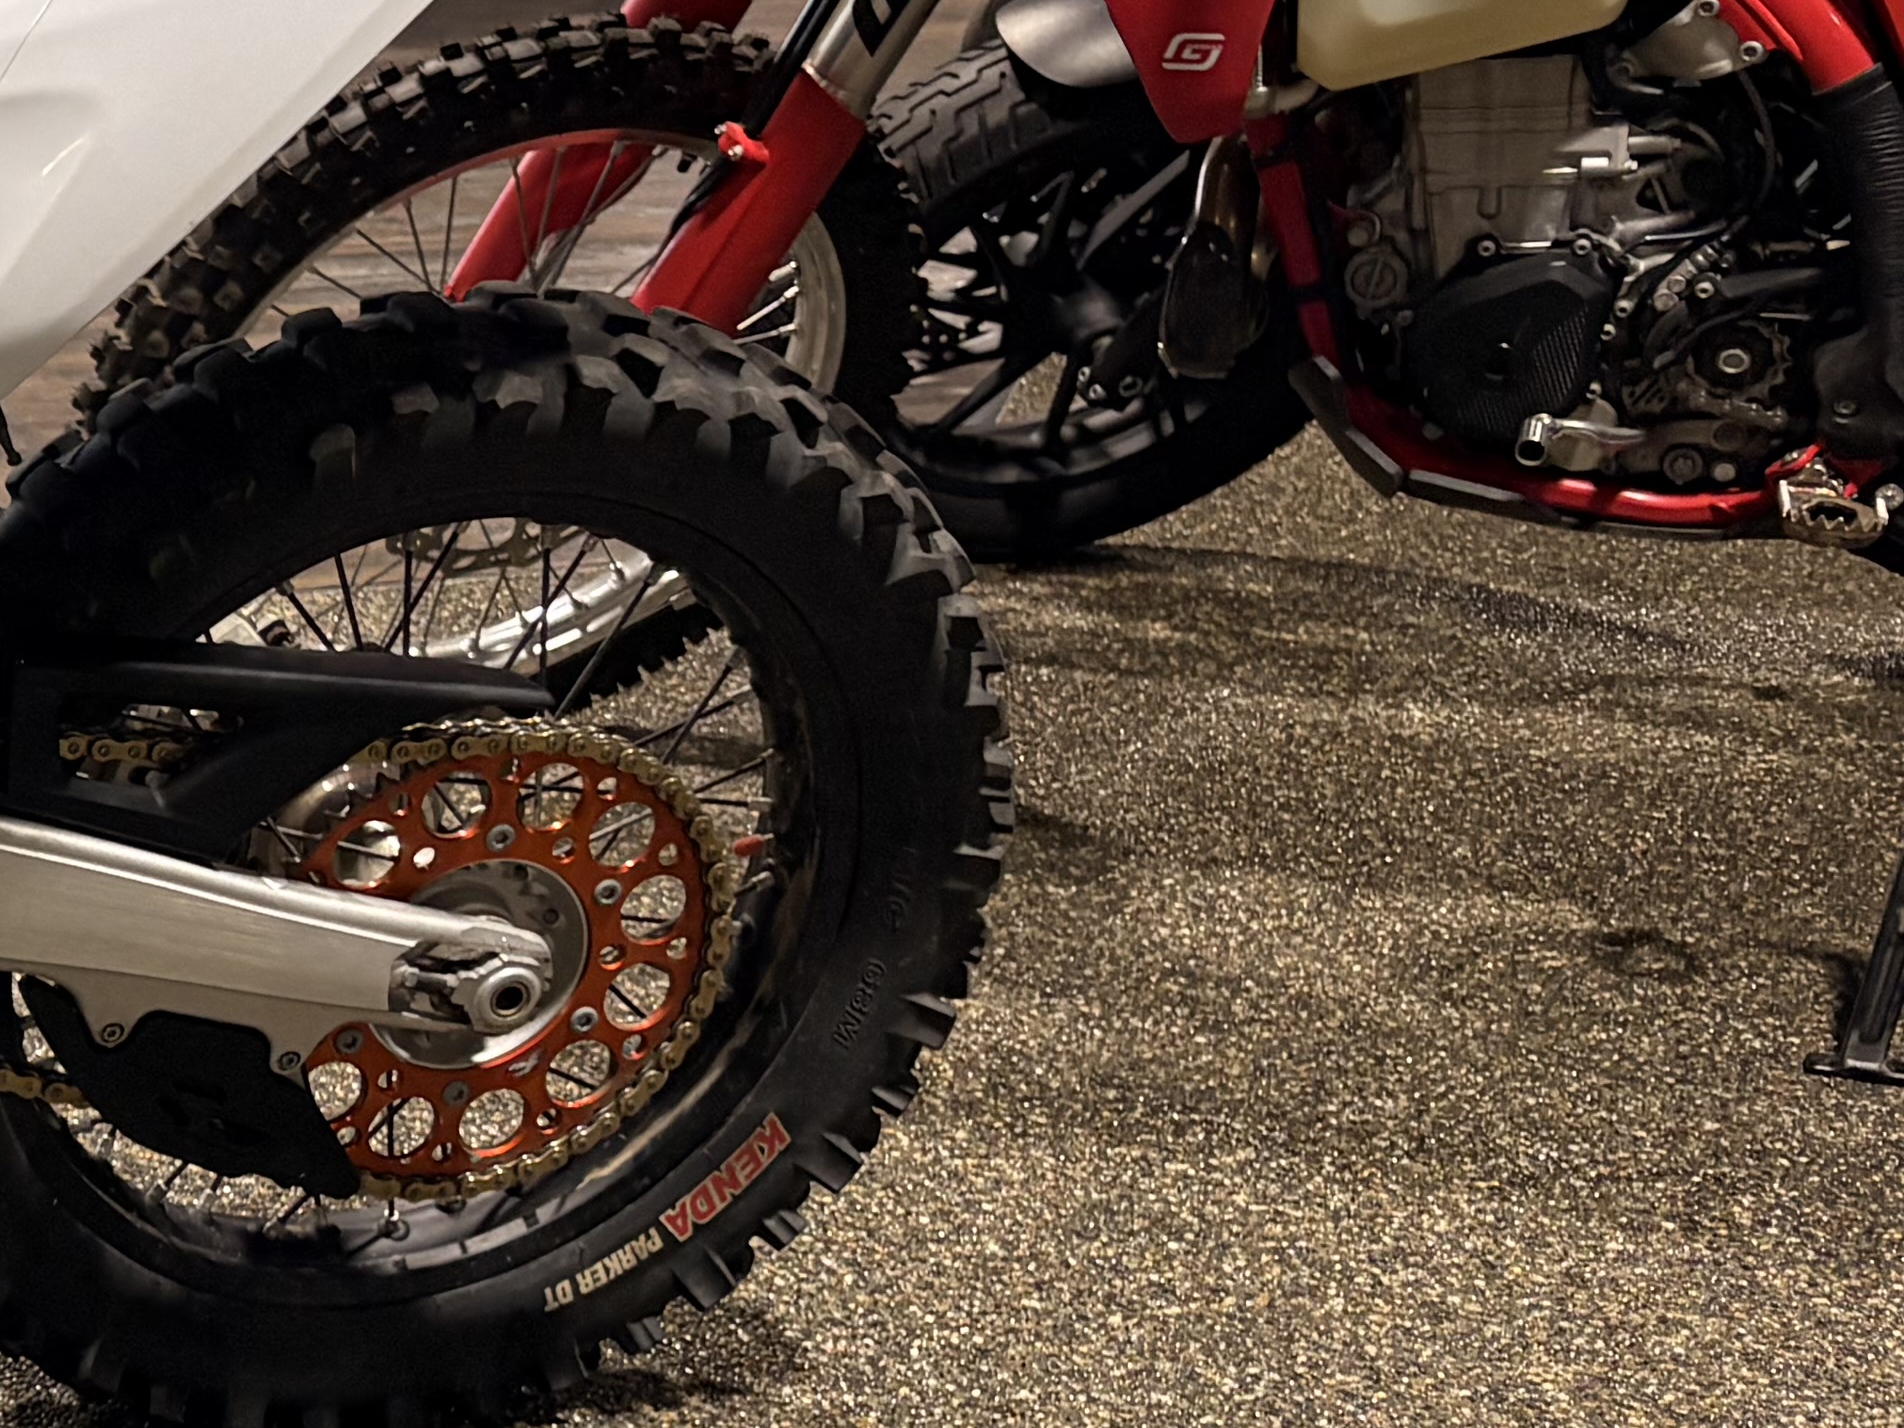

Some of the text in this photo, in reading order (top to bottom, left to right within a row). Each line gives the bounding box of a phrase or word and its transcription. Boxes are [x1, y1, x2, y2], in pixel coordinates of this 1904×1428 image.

[543, 1111, 792, 1312] KENDA PARKER DT
